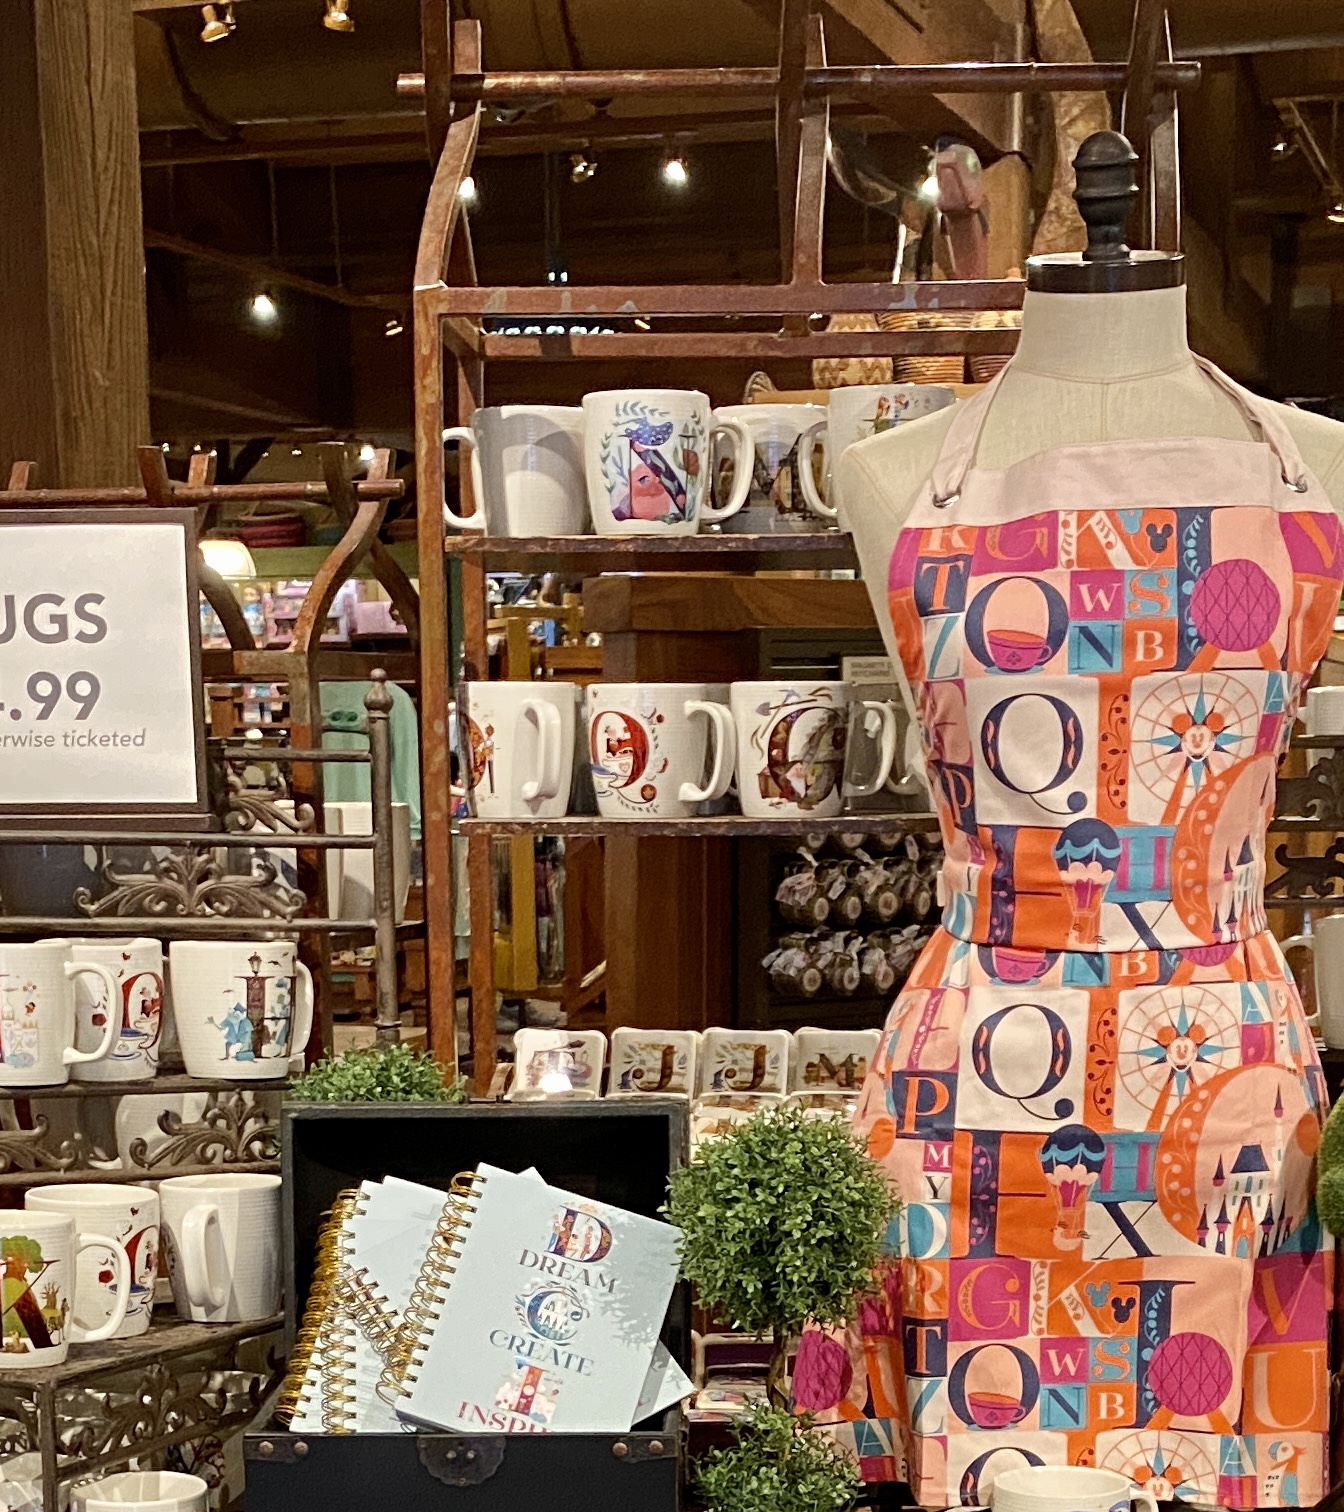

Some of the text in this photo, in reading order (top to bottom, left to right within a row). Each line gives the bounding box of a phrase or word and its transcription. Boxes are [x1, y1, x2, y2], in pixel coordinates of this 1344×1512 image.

[62, 728, 147, 748] ticketed
[518, 1248, 617, 1295] DREAM
[489, 1329, 595, 1377] CREATE
